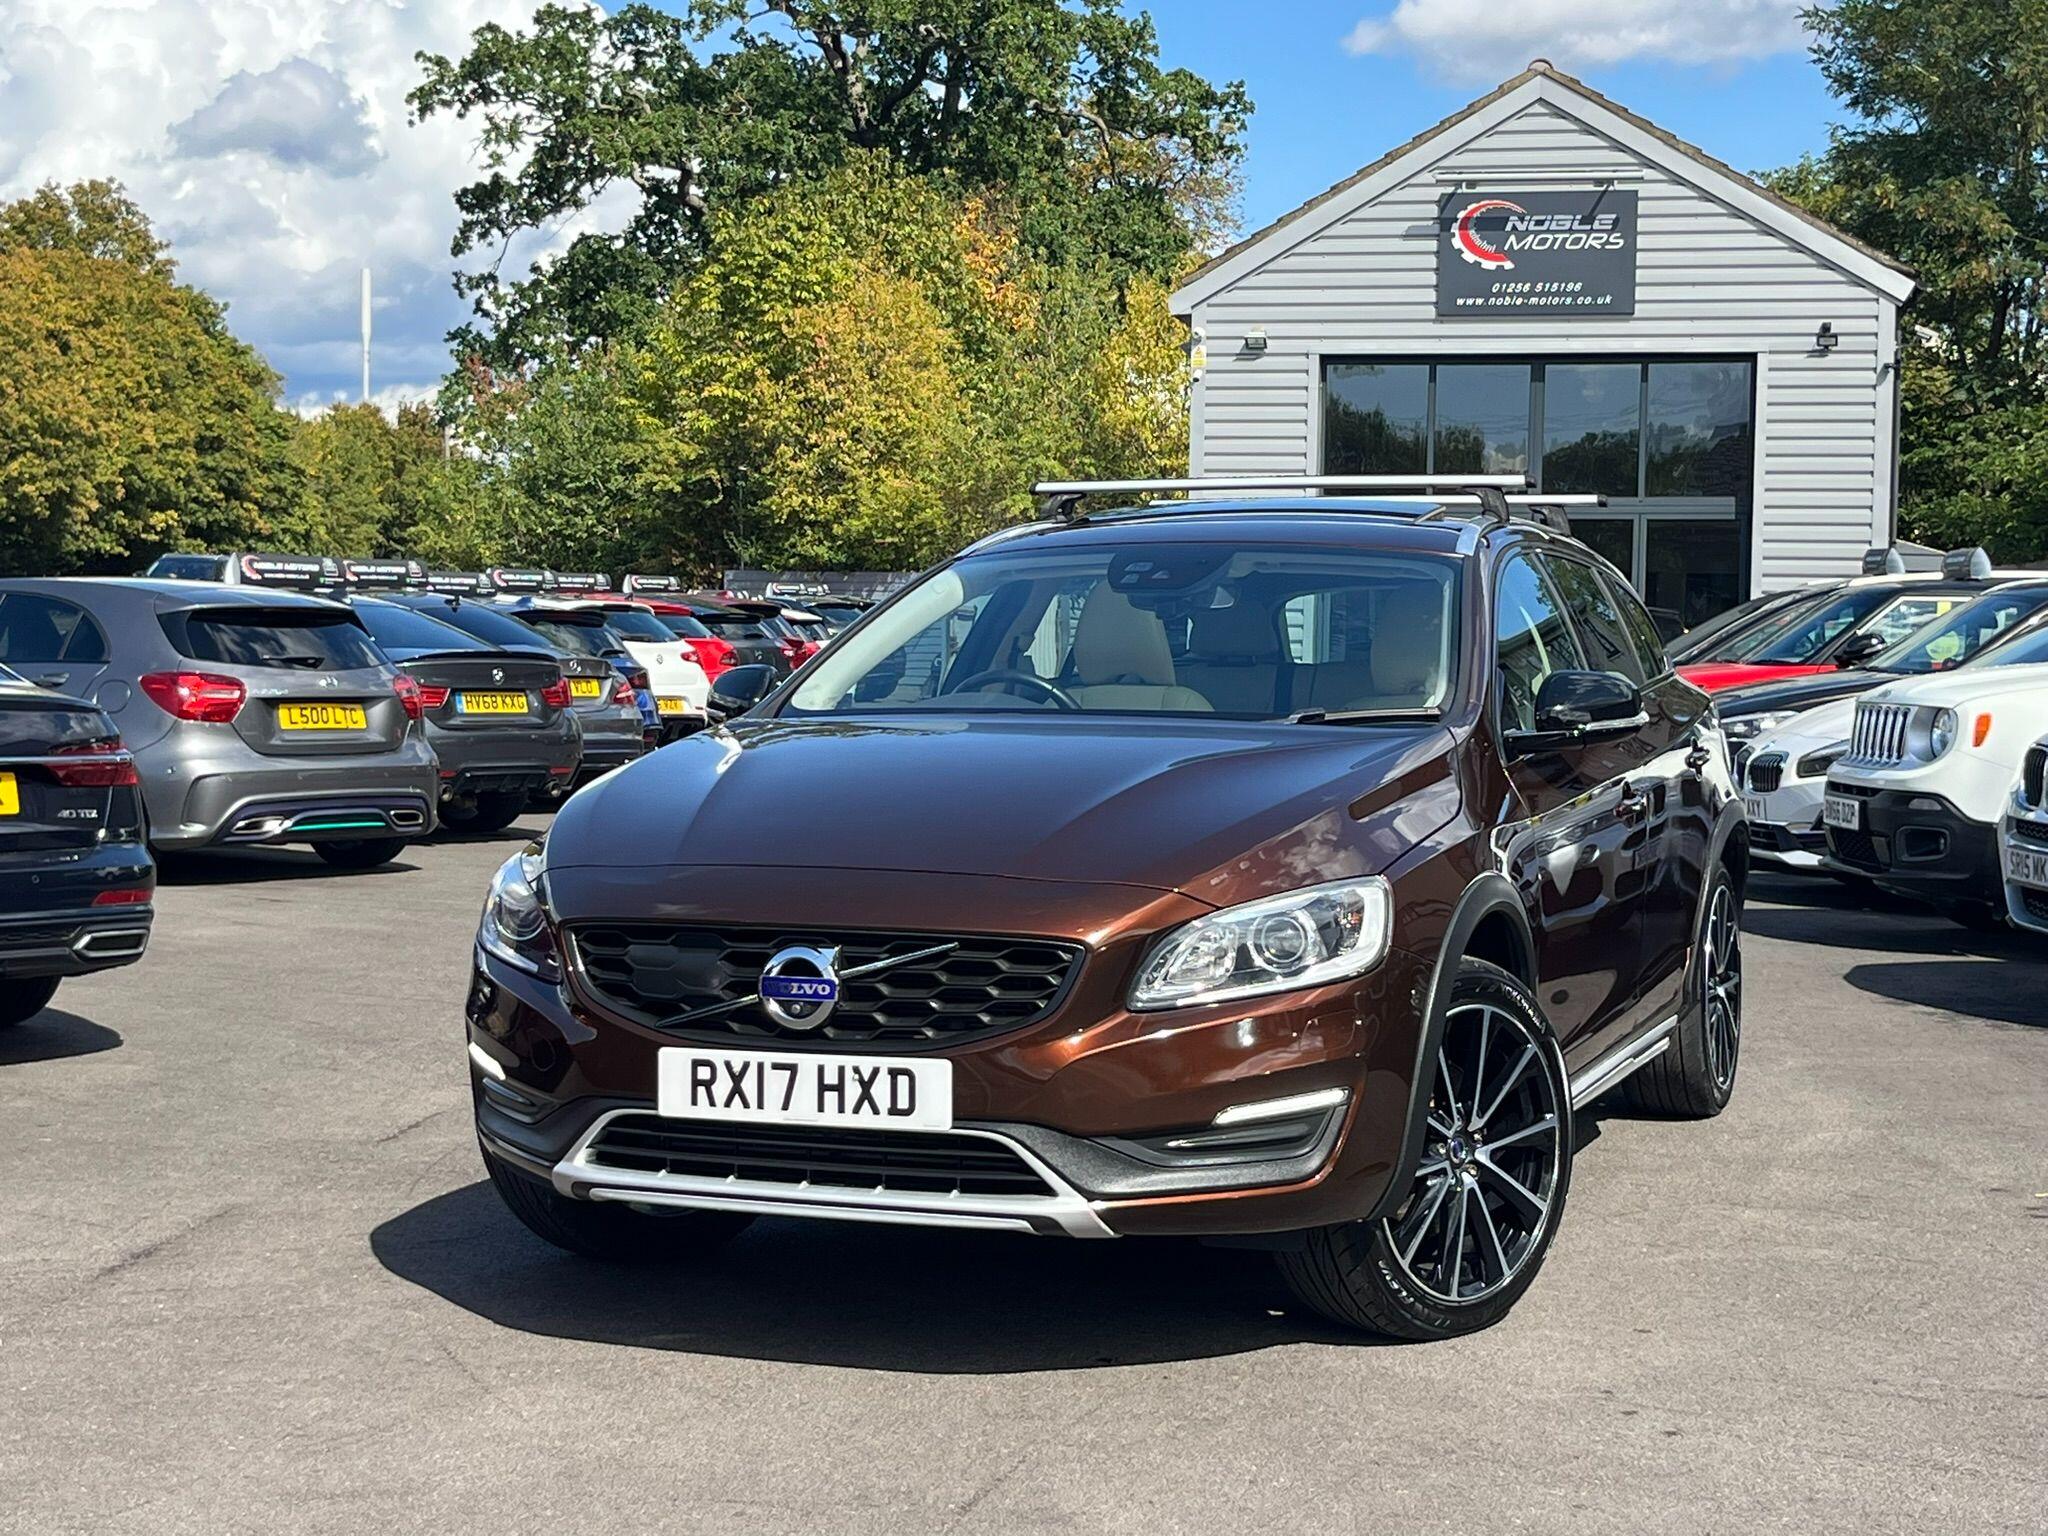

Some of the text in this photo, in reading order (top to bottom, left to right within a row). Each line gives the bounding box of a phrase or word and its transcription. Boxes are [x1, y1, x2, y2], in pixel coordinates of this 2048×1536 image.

[1505, 213, 1618, 232] NOBLE
[1503, 232, 1625, 250] MOTORS
[1491, 282, 1530, 293] 01256
[1456, 294, 1613, 306] www.noble-motors.co.uk
[464, 694, 498, 710] HV68
[288, 706, 359, 725] L500 LTC
[690, 1058, 917, 1117] RX17 HXD
